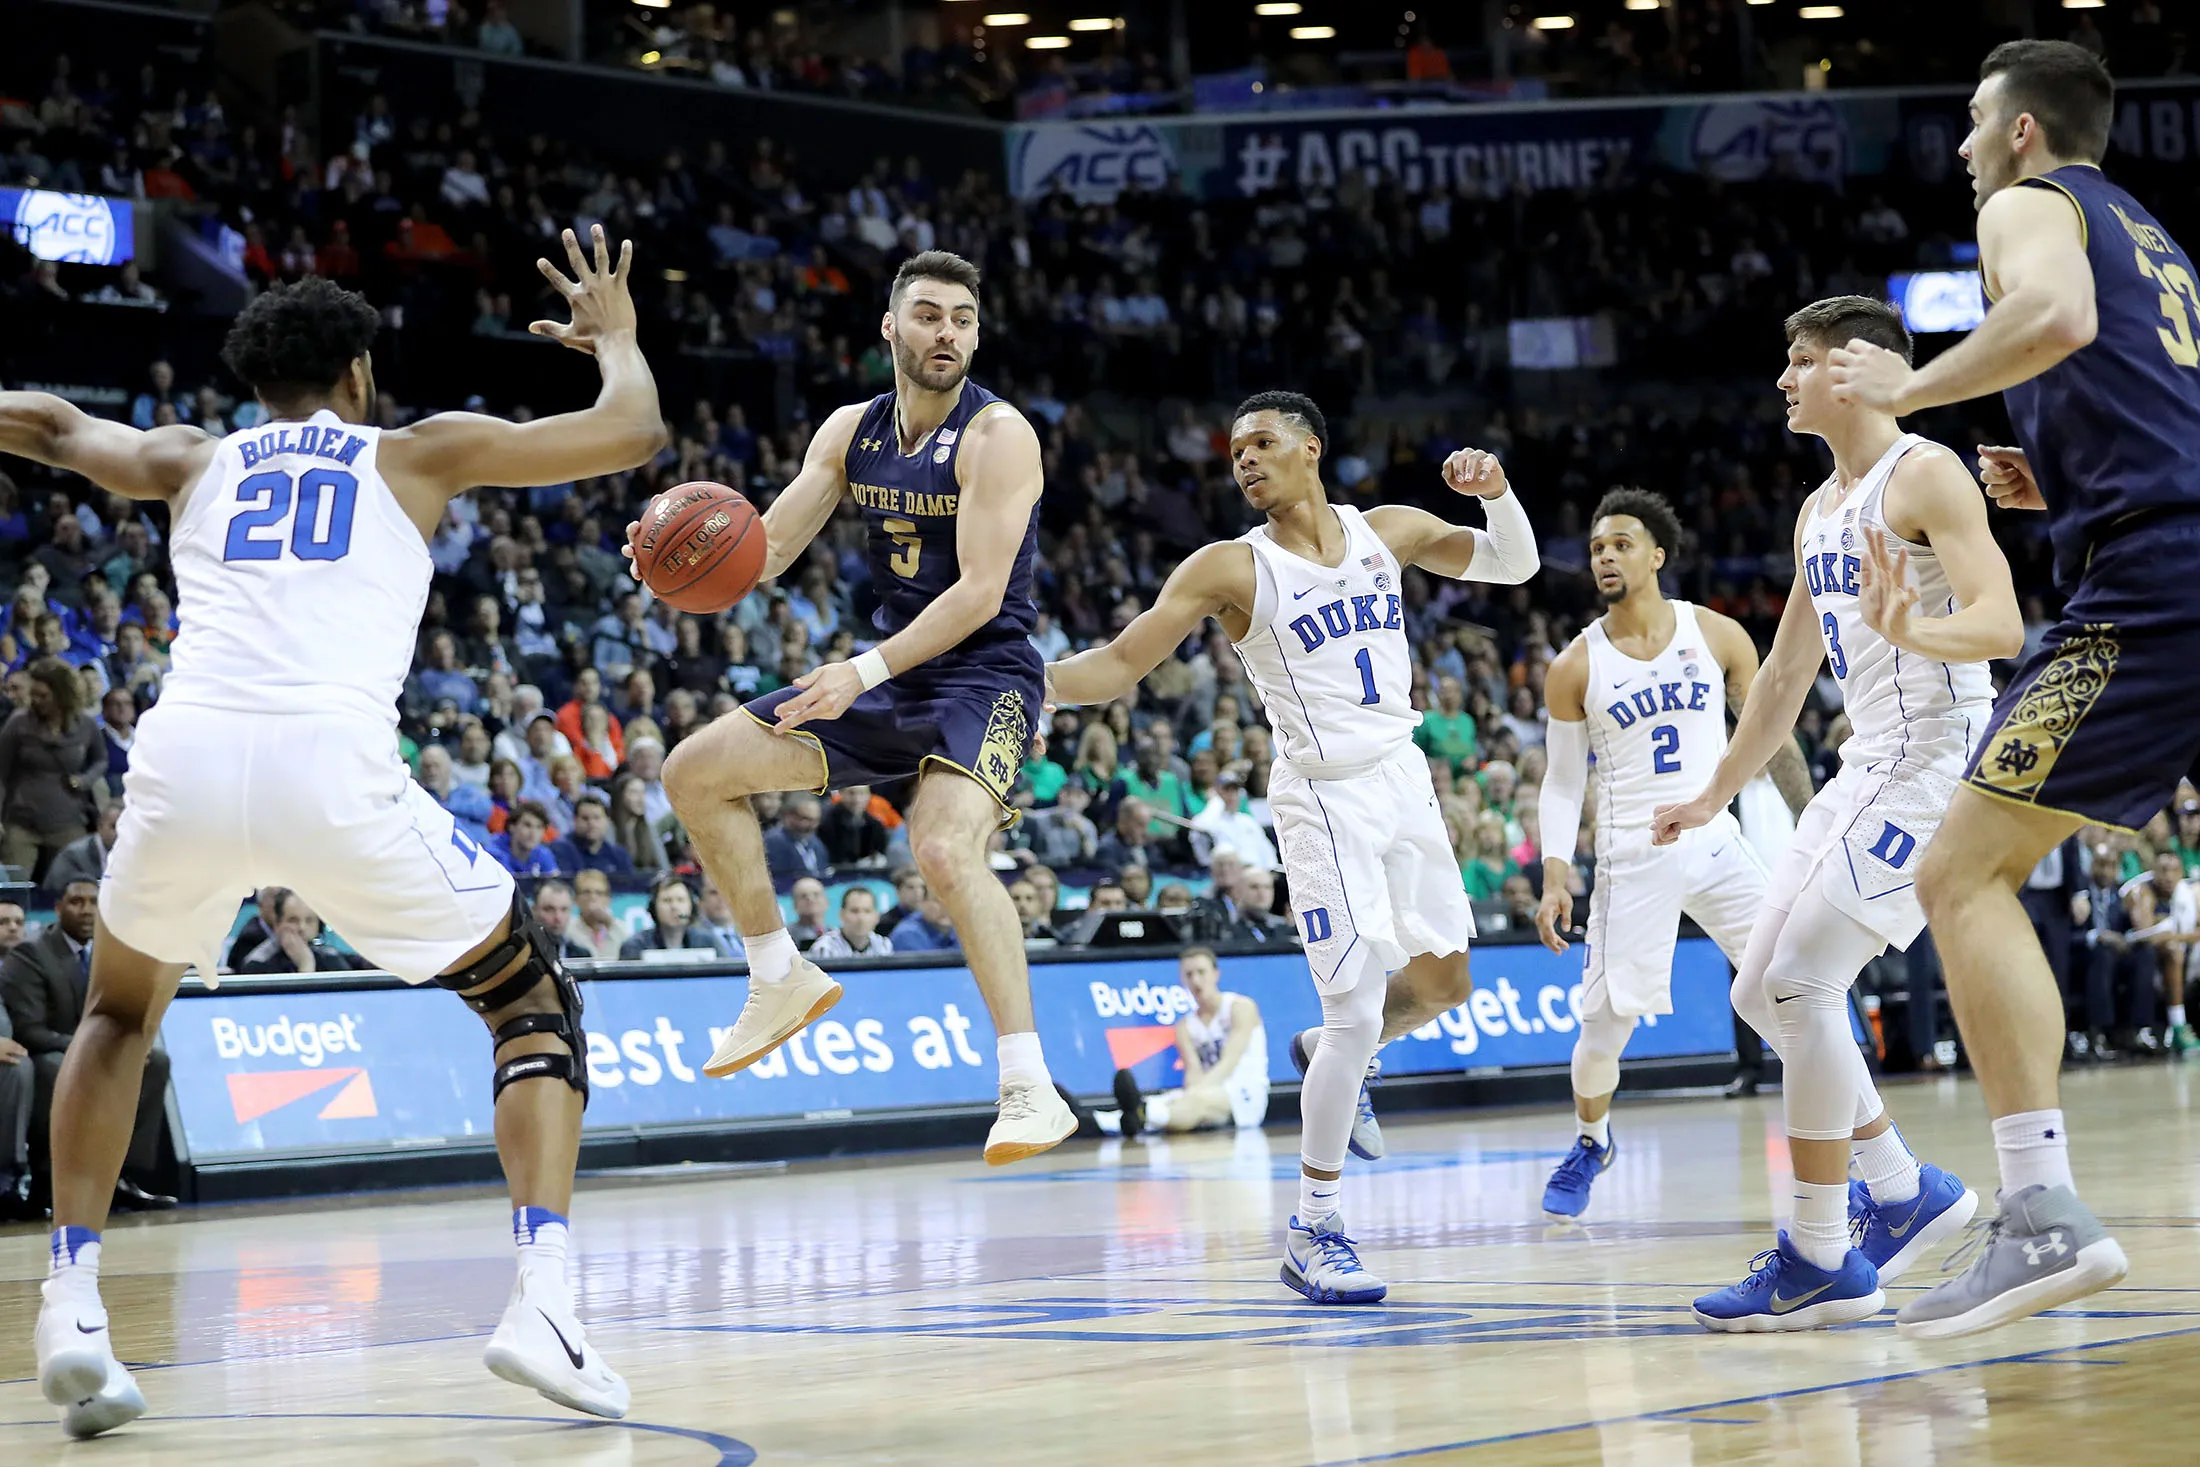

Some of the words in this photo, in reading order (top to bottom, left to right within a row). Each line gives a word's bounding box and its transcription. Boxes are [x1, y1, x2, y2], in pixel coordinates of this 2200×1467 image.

[1035, 150, 1162, 187] ACC
[33, 212, 105, 239] ACC
[238, 426, 368, 470] BOLDEN
[223, 467, 359, 562] 20
[849, 482, 900, 512] NOTRE
[904, 491, 958, 516] DAME
[882, 517, 922, 579] 5
[1805, 552, 1862, 598] UKE
[1288, 593, 1402, 654] DUKE
[1823, 611, 1849, 680] 3
[1354, 647, 1381, 706] 1
[1607, 681, 1711, 730] DUKE
[1651, 724, 1682, 775] 2
[211, 1013, 363, 1068] Budget
[586, 1016, 697, 1088] est
[908, 1003, 984, 1071] at
